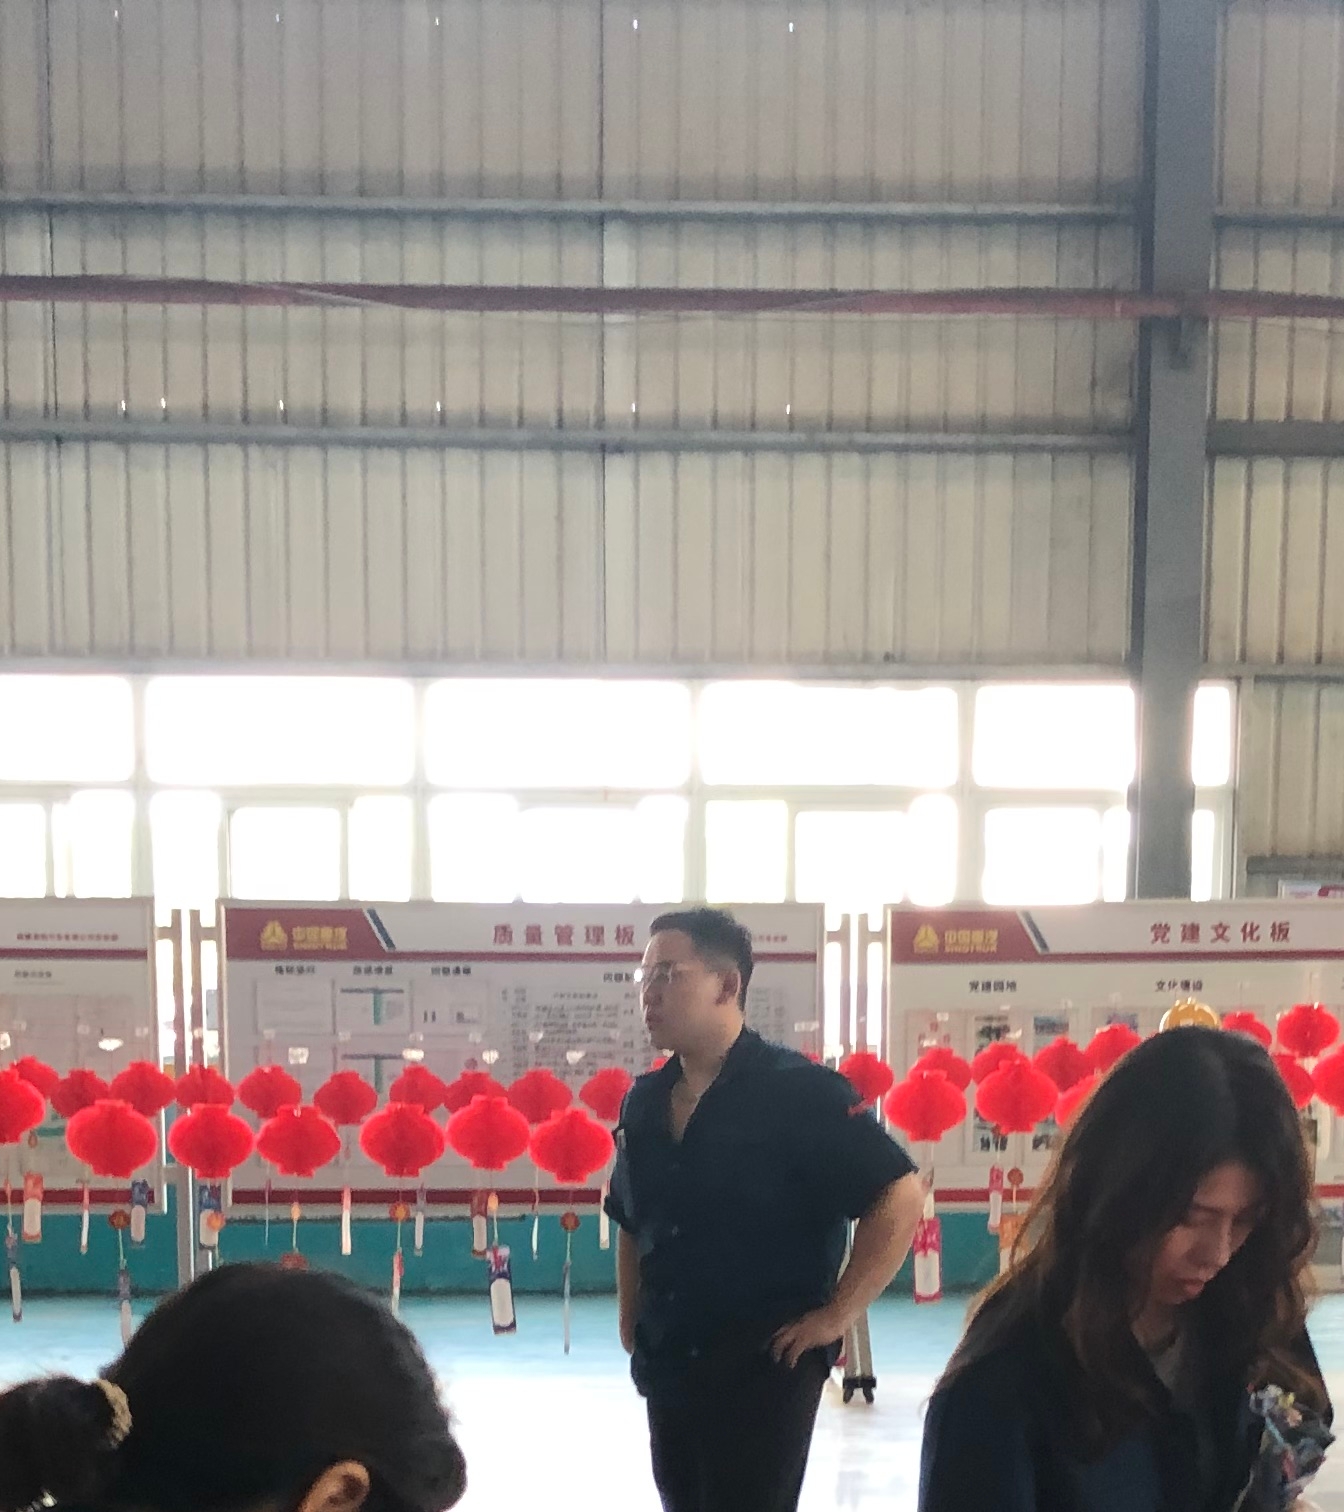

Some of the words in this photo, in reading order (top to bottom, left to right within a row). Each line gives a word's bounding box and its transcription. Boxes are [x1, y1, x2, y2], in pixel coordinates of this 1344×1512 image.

[493, 923, 636, 947] 质量管理板
[1150, 921, 1291, 945] 党建文化板
